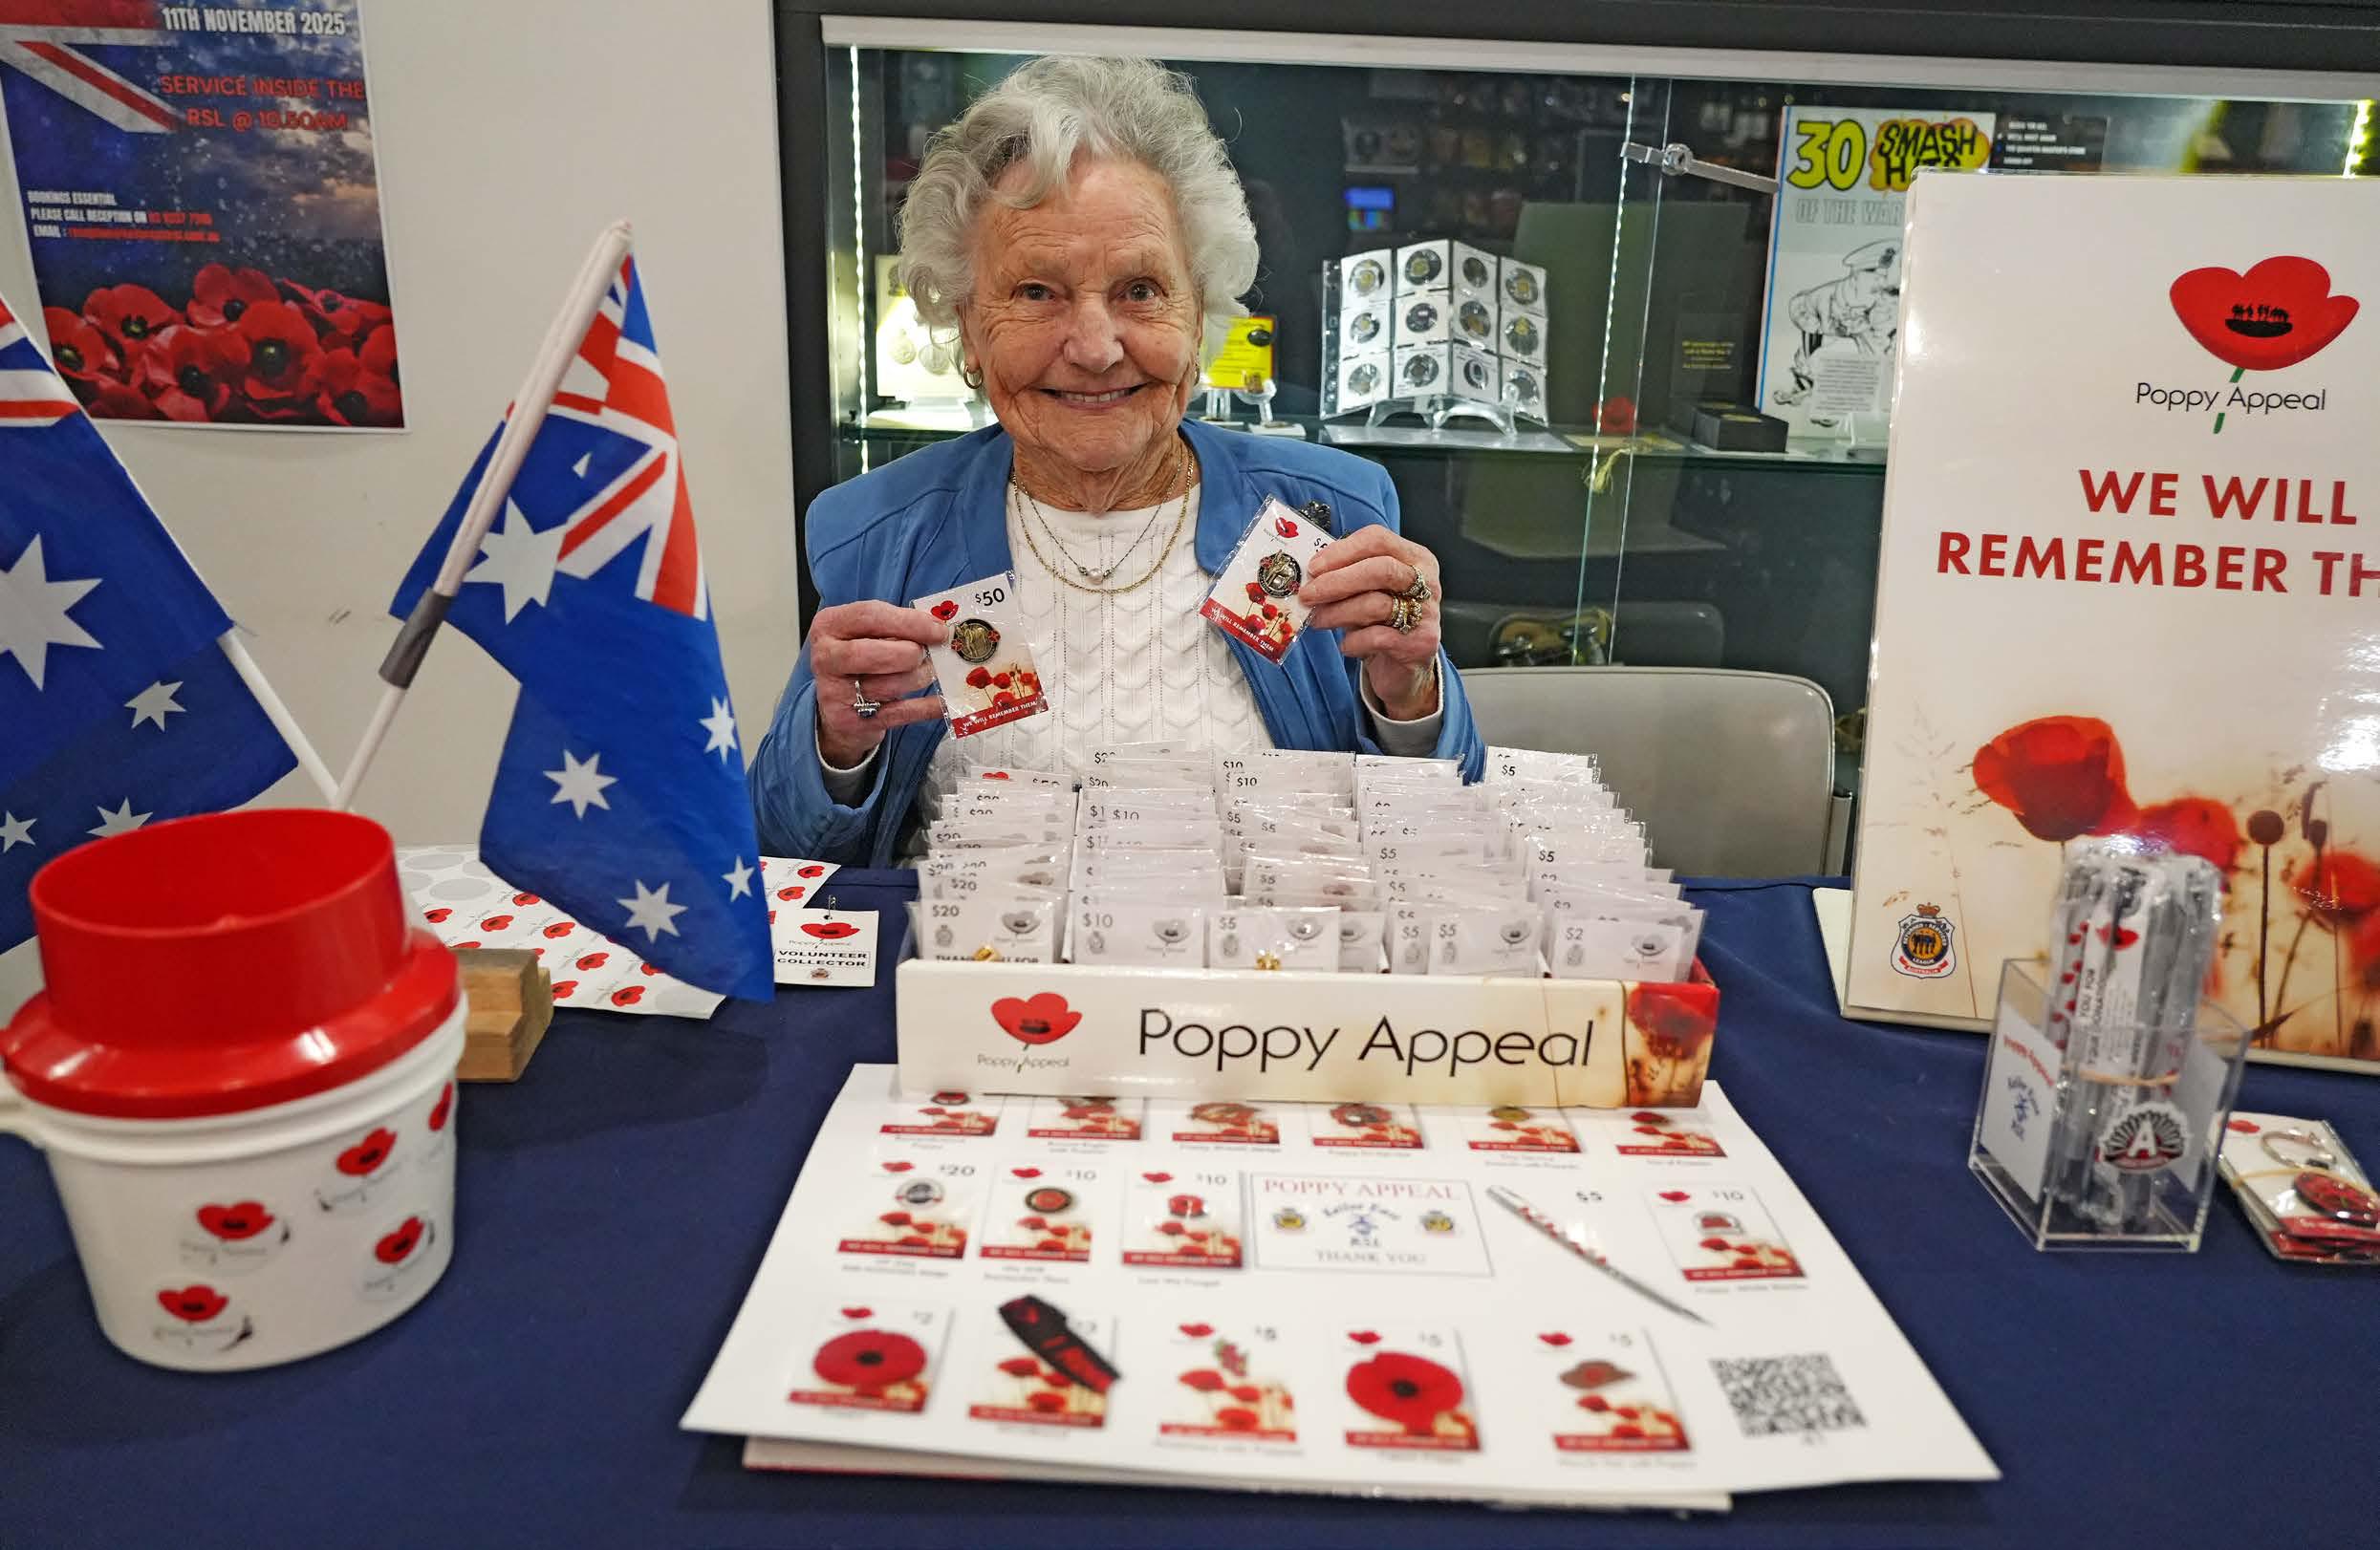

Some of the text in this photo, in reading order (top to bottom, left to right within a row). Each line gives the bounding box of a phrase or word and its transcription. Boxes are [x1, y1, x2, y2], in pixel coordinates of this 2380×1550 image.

[162, 8, 346, 35] 11TH NOVEMBER 2025
[160, 75, 365, 99] SERVICE INSIDE THE
[185, 108, 227, 128] RSL
[232, 111, 253, 131] @
[1877, 122, 1979, 158] SMASH
[1786, 118, 1867, 191] 30
[2135, 381, 2326, 415] Poppy Appeal
[2078, 469, 2357, 526] WE WILL
[1936, 531, 2288, 593] REMEMBER
[974, 588, 1006, 607] $50
[1233, 621, 1260, 642] REMEMBER
[1260, 639, 1275, 653] THEM
[988, 705, 1019, 720] REMEMBER
[1020, 700, 1037, 711] THEM
[1502, 764, 1516, 777] $5
[1237, 776, 1258, 787] $10
[1113, 808, 1139, 821] $10
[1227, 811, 1242, 824] $5
[1262, 822, 1277, 833] $5
[1380, 848, 1397, 860] $5
[1538, 849, 1555, 863] $5
[951, 878, 978, 893] $20
[932, 904, 961, 918] $20
[1081, 913, 1114, 929] $10
[1219, 916, 1237, 931] $5
[1402, 925, 1420, 939] $5
[1439, 923, 1457, 937] $5
[1565, 927, 1584, 941] $2
[779, 949, 868, 959] VOLUNTEER
[777, 958, 866, 967] COLLECTOR
[1139, 1007, 1594, 1078] Poppy Appeal
[977, 1053, 1071, 1068] Poppy Appeal
[1264, 1177, 1462, 1201] POPPY APPEAL
[1315, 1248, 1381, 1264] THANK
